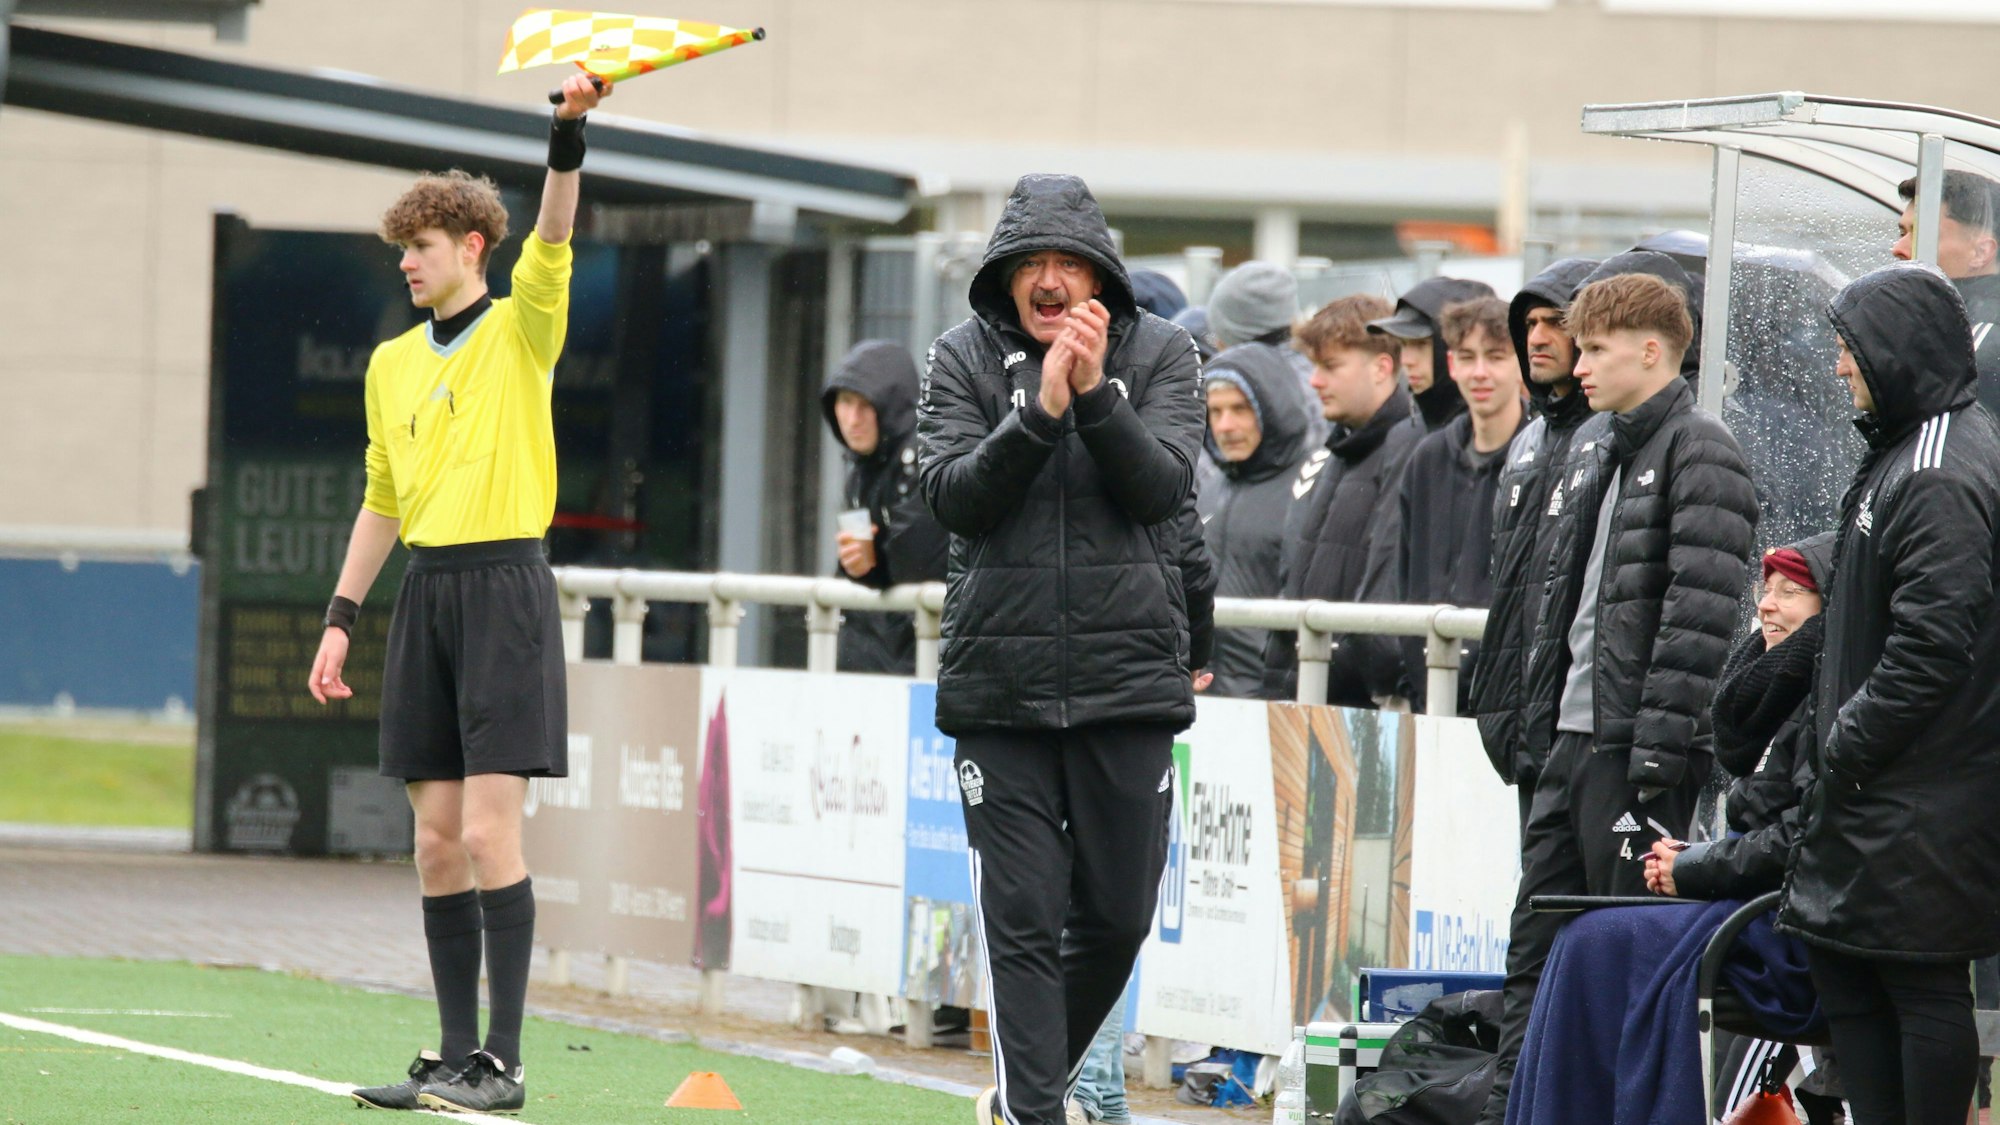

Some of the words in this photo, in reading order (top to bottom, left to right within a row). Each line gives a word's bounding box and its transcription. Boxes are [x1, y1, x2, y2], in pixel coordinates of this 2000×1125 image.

[237, 464, 337, 517] GUTE
[1510, 484, 1521, 508] 9
[1191, 781, 1252, 866] Eifel-Home
[1612, 824, 1642, 833] adidas
[1620, 837, 1633, 861] 4
